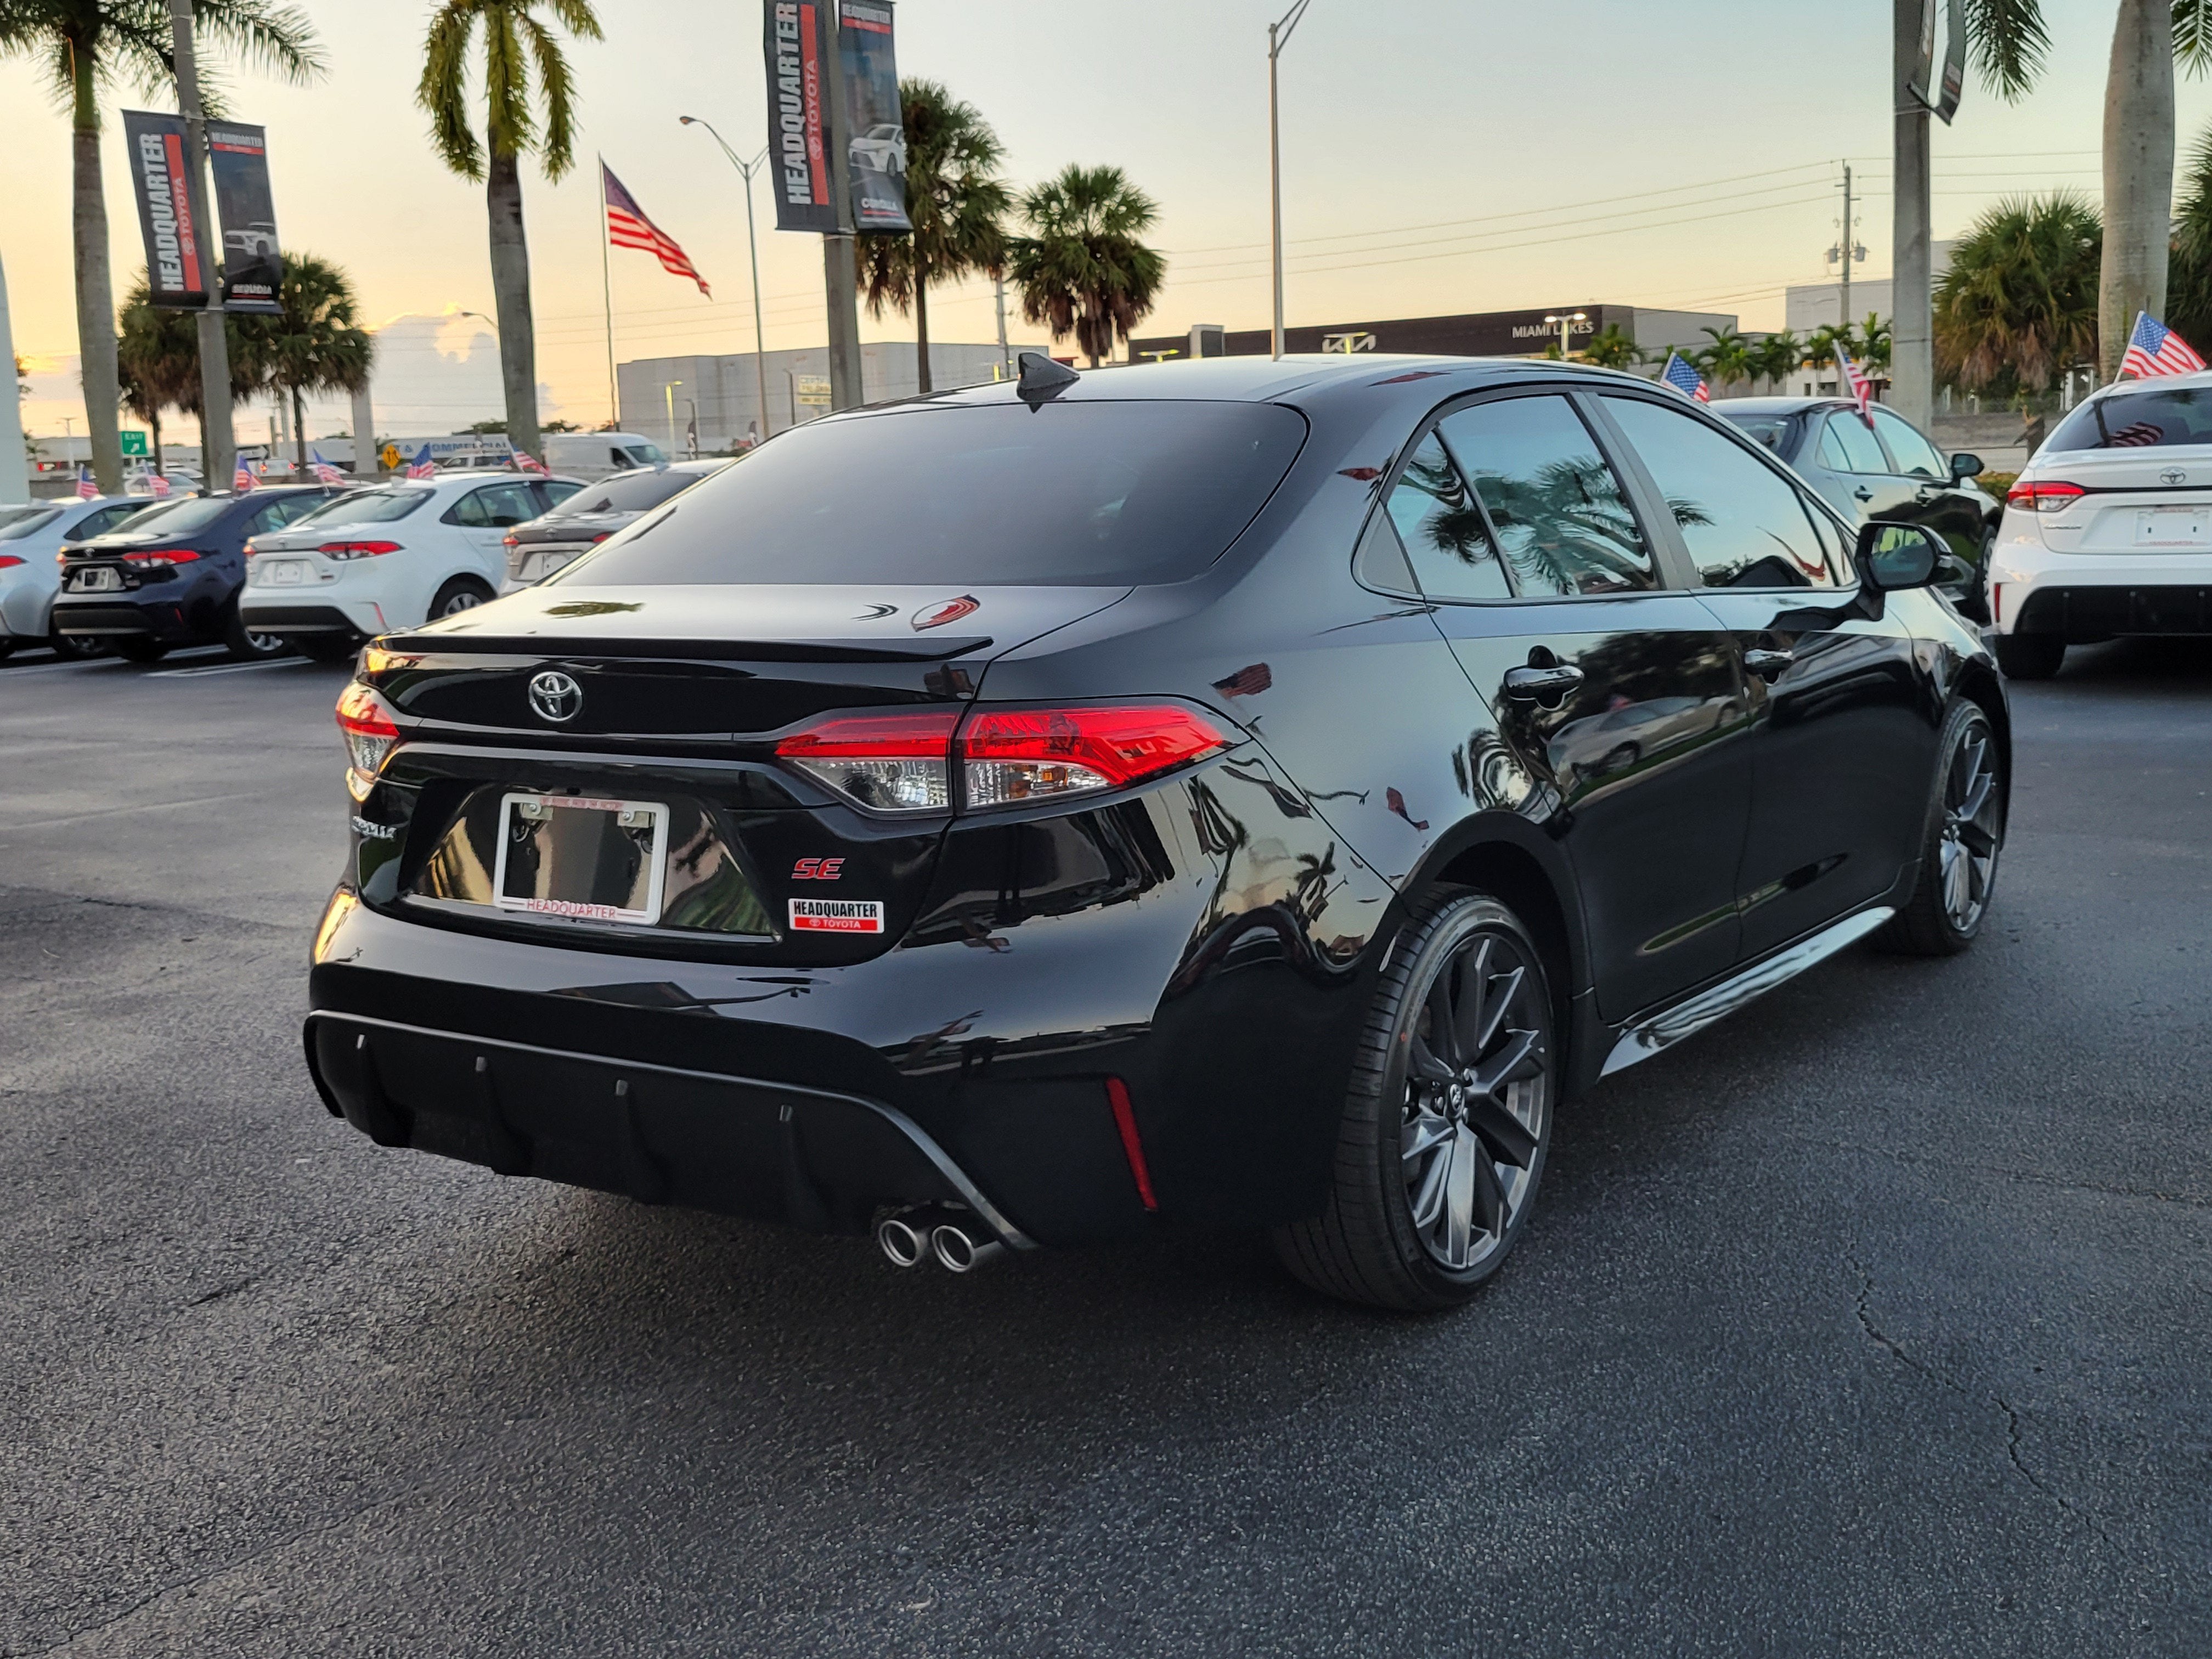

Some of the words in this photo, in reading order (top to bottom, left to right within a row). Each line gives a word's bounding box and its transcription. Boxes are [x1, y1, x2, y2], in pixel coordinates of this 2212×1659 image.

[775, 3, 812, 205] HEADQUARTER
[806, 59, 819, 133] TOYOTA
[139, 133, 184, 291] HEADQUARTER
[174, 177, 191, 234] TOYOTA
[1511, 324, 1551, 338] MIAMI
[1553, 321, 1595, 336] LKES
[791, 857, 846, 880] SE
[527, 898, 616, 918] HEADQUARTER
[794, 901, 878, 918] HEADQUARTER
[823, 919, 861, 929] TOYOTA
